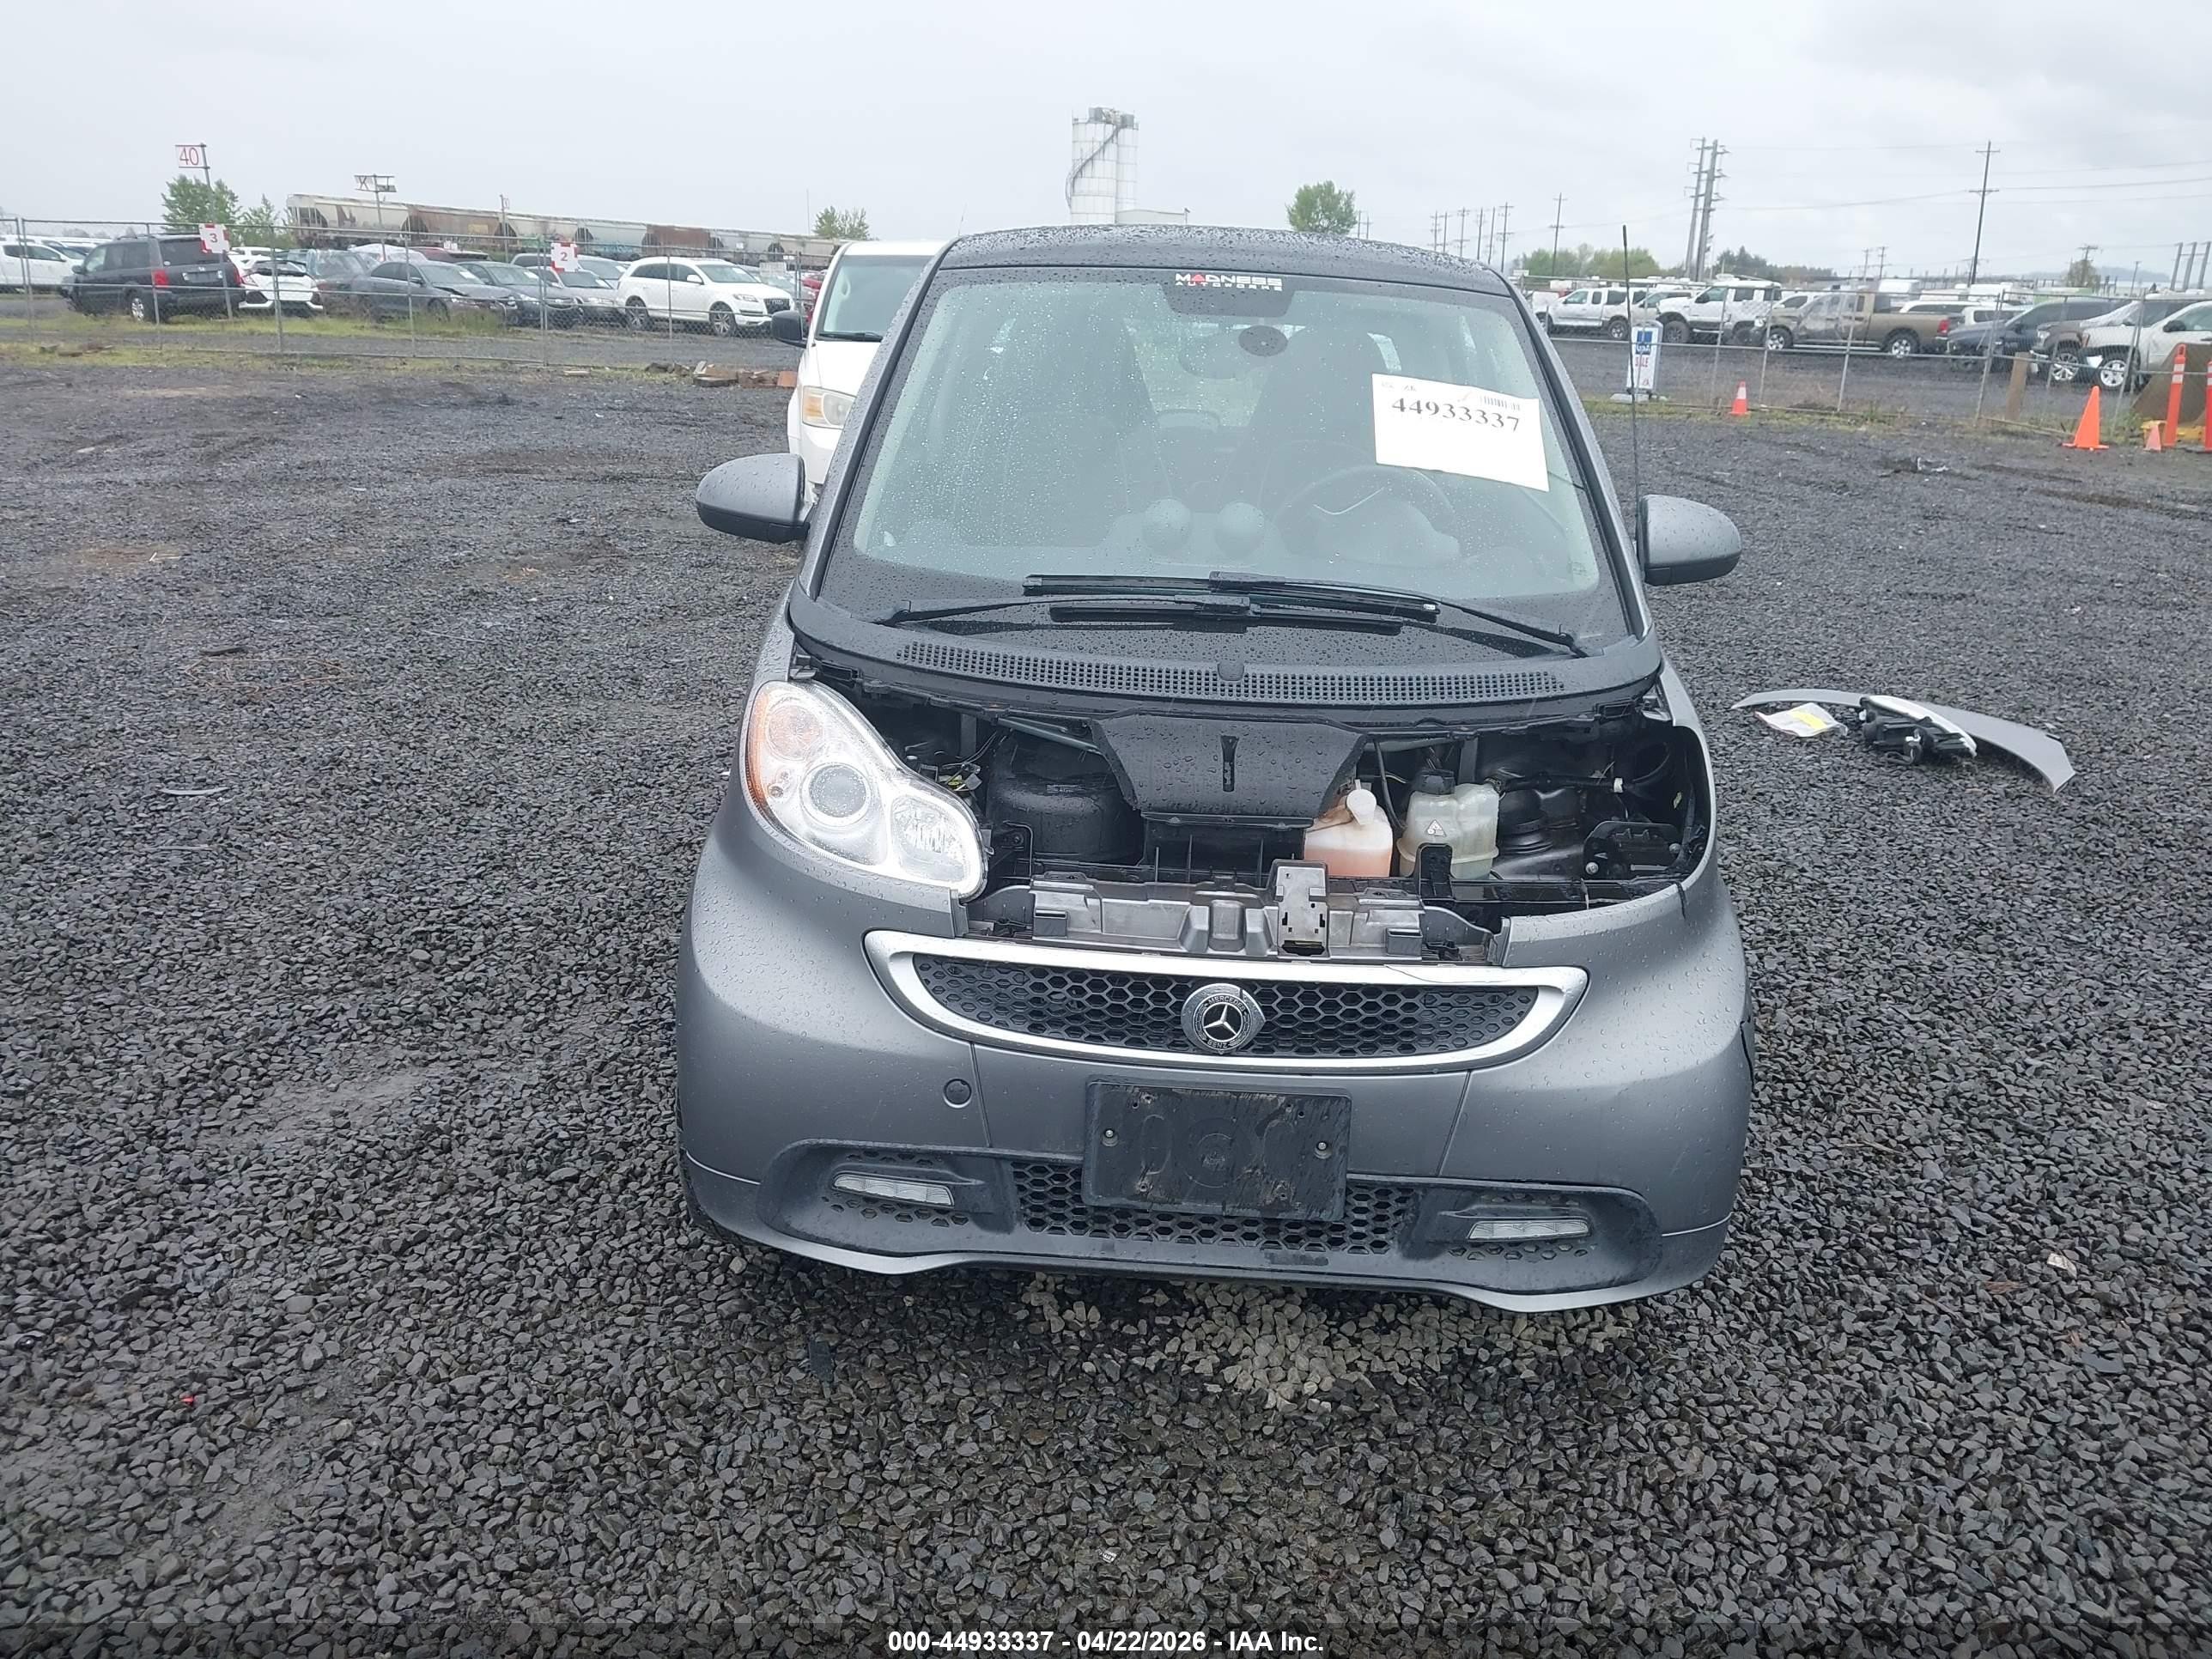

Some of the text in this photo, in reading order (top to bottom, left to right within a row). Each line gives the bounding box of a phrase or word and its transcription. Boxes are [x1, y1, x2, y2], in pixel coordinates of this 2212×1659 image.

[179, 147, 199, 166] 40
[210, 233, 218, 243] 3
[560, 252, 568, 262] 2
[1175, 273, 1282, 287] MADNESS
[1392, 398, 1519, 432] 44933337
[1208, 995, 1246, 1012] MERCEDES
[1207, 1039, 1228, 1048] BENZ
